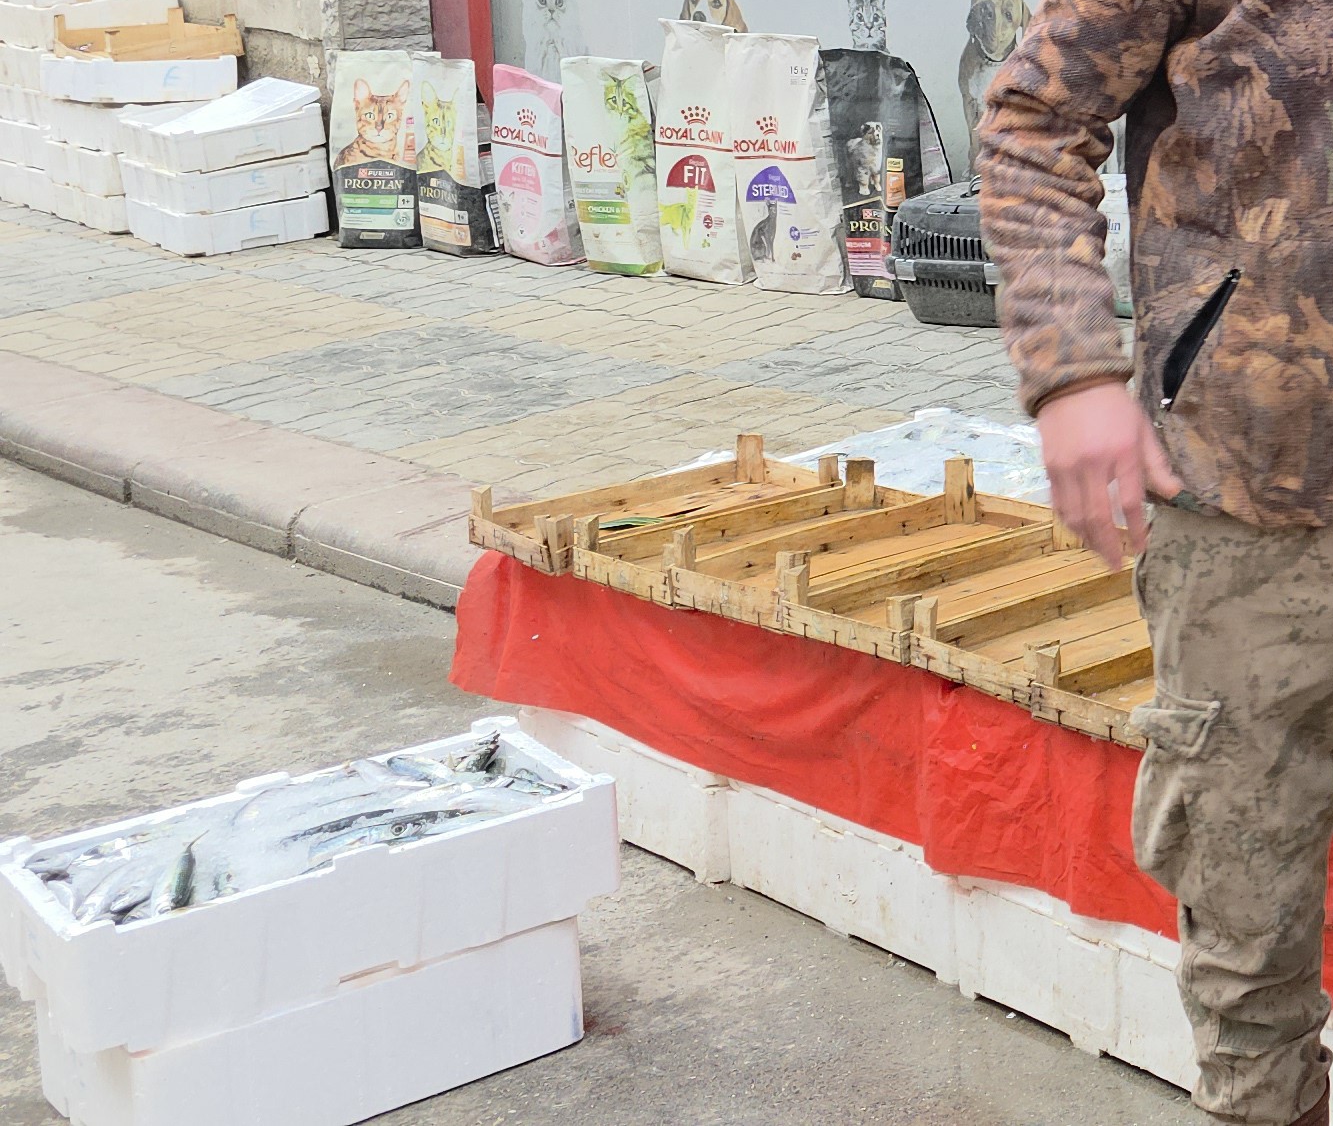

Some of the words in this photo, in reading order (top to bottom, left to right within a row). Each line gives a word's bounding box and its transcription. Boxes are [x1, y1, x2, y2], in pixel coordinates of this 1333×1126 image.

[789, 65, 798, 75] 15
[493, 125, 526, 143] ROYAL
[659, 126, 696, 141] ROYAL
[733, 139, 772, 153] ROYAL
[683, 165, 707, 185] FIT
[344, 178, 373, 189] PRO
[373, 179, 404, 190] PLAN
[420, 186, 440, 199] PRO
[850, 220, 880, 233] PRO
